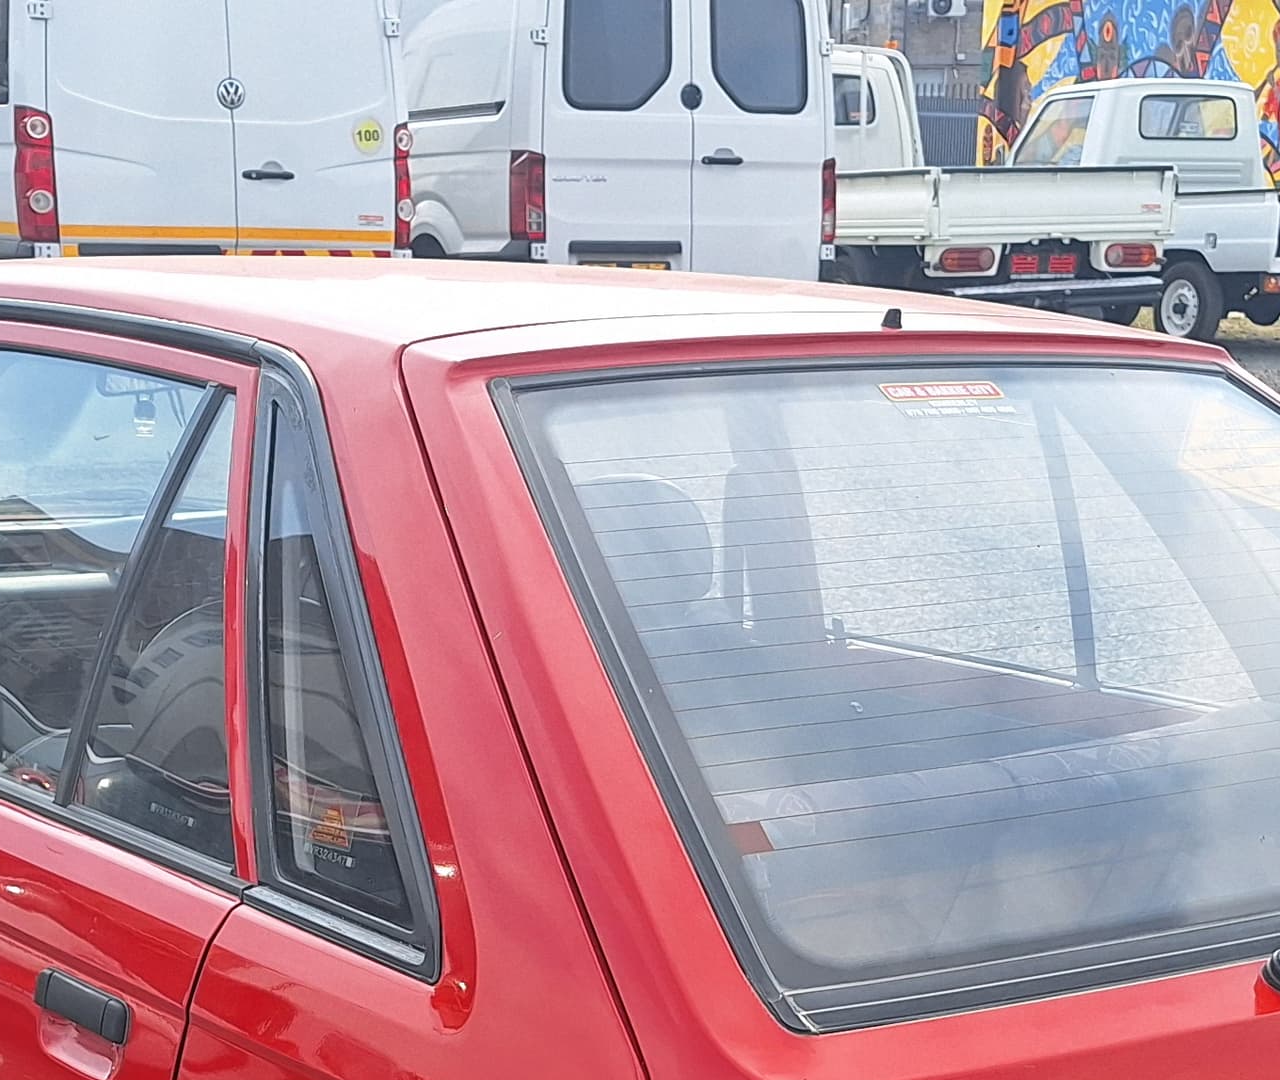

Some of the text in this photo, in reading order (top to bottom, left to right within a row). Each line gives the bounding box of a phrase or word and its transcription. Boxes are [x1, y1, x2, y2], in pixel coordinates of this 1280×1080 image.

[218, 79, 244, 108] VW
[355, 129, 380, 142] 100
[887, 386, 916, 398] CAR
[968, 384, 997, 396] CITY
